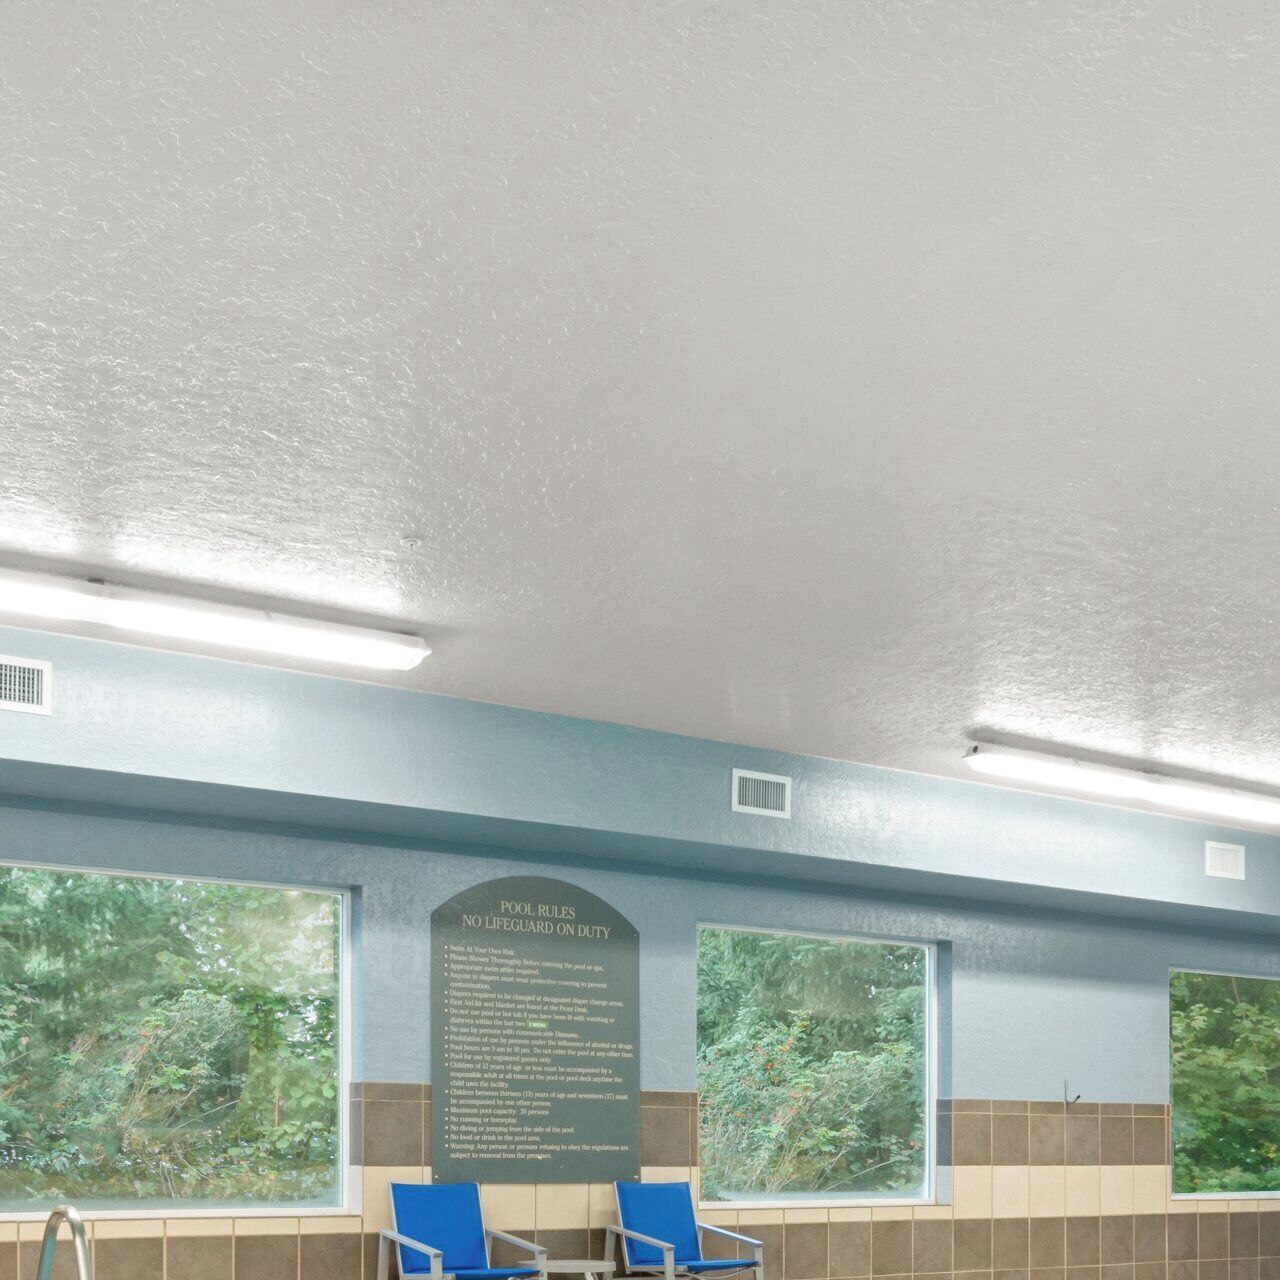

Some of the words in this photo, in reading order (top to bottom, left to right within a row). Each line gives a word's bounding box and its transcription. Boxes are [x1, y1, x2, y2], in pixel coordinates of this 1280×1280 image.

[501, 901, 535, 916] POOL
[538, 904, 576, 920] RULES
[462, 914, 481, 928] NO
[485, 916, 554, 934] LIFEGUARD
[557, 922, 575, 936] ON
[578, 924, 611, 939] DUTY
